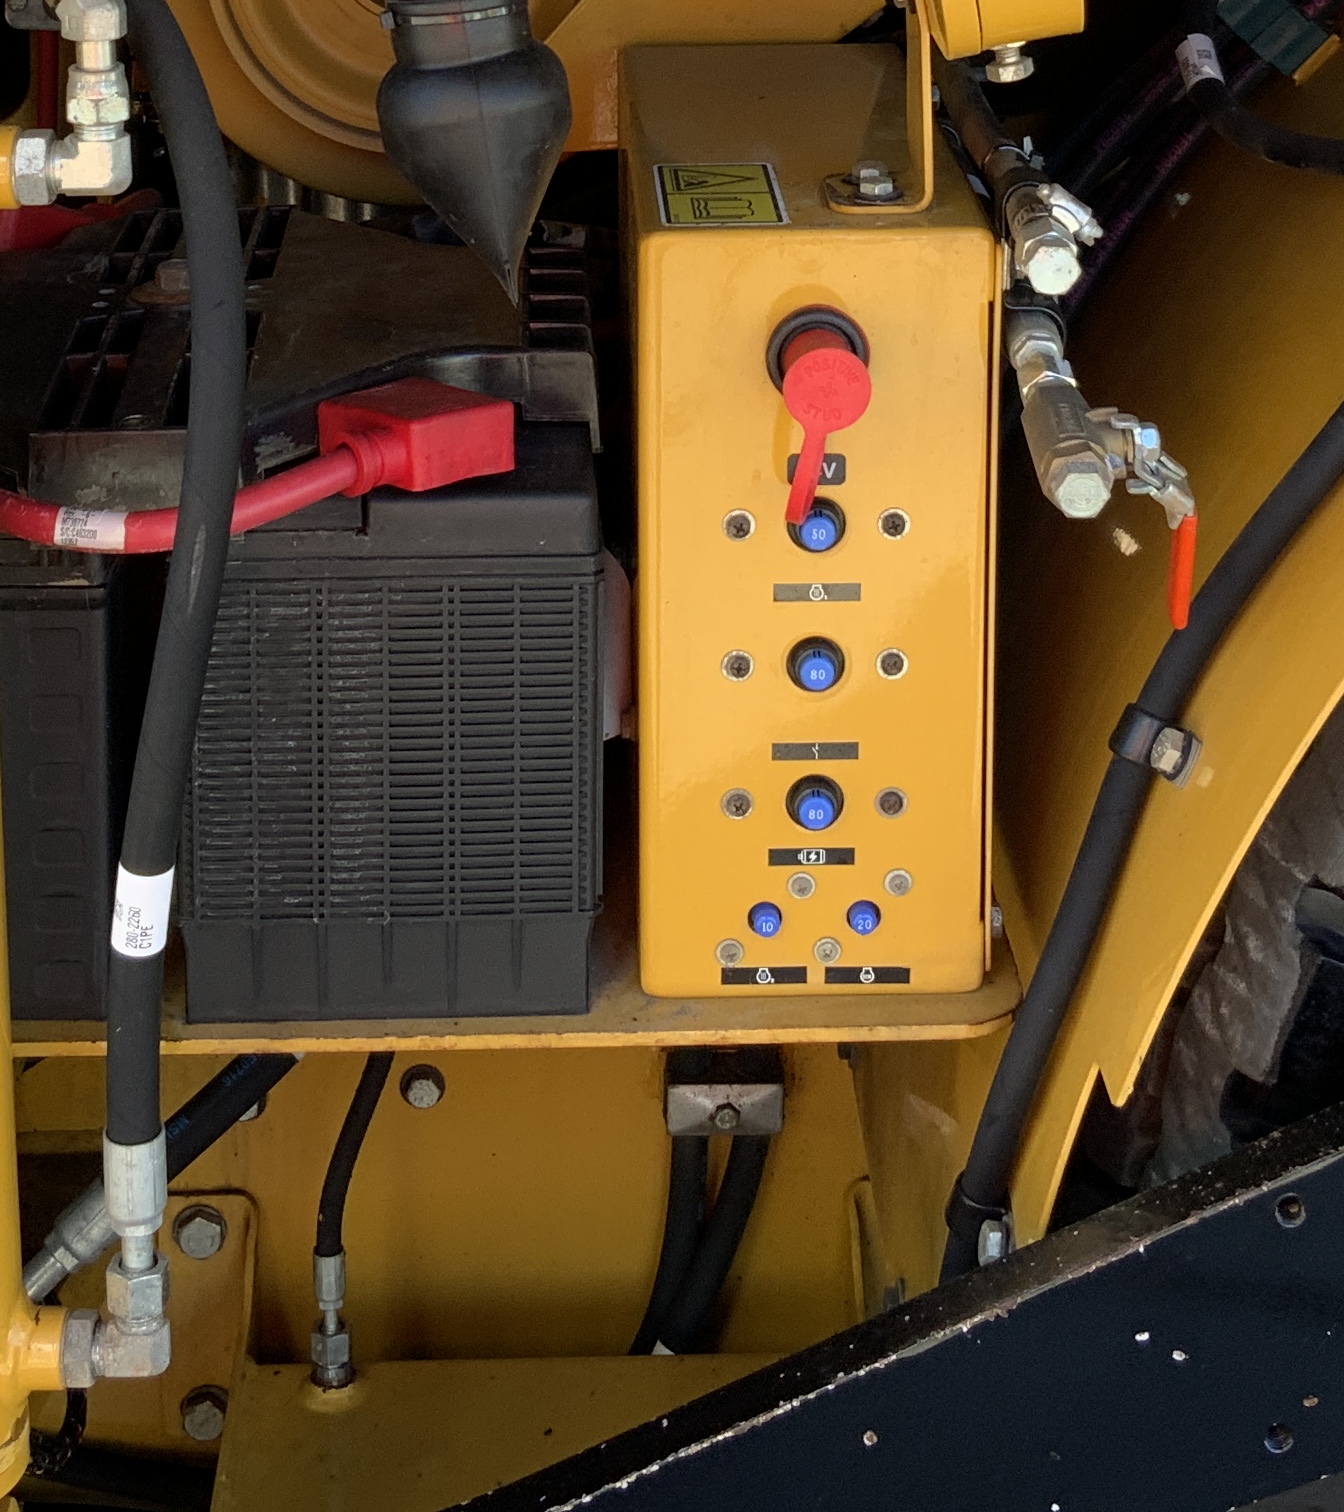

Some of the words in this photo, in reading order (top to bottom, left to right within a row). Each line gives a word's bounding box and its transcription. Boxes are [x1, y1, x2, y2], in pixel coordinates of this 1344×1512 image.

[811, 528, 826, 540] 50
[809, 669, 826, 680] 80
[808, 809, 824, 820] 80
[762, 921, 774, 933] 10
[857, 919, 872, 930] 20
[138, 924, 154, 950] C1PE
